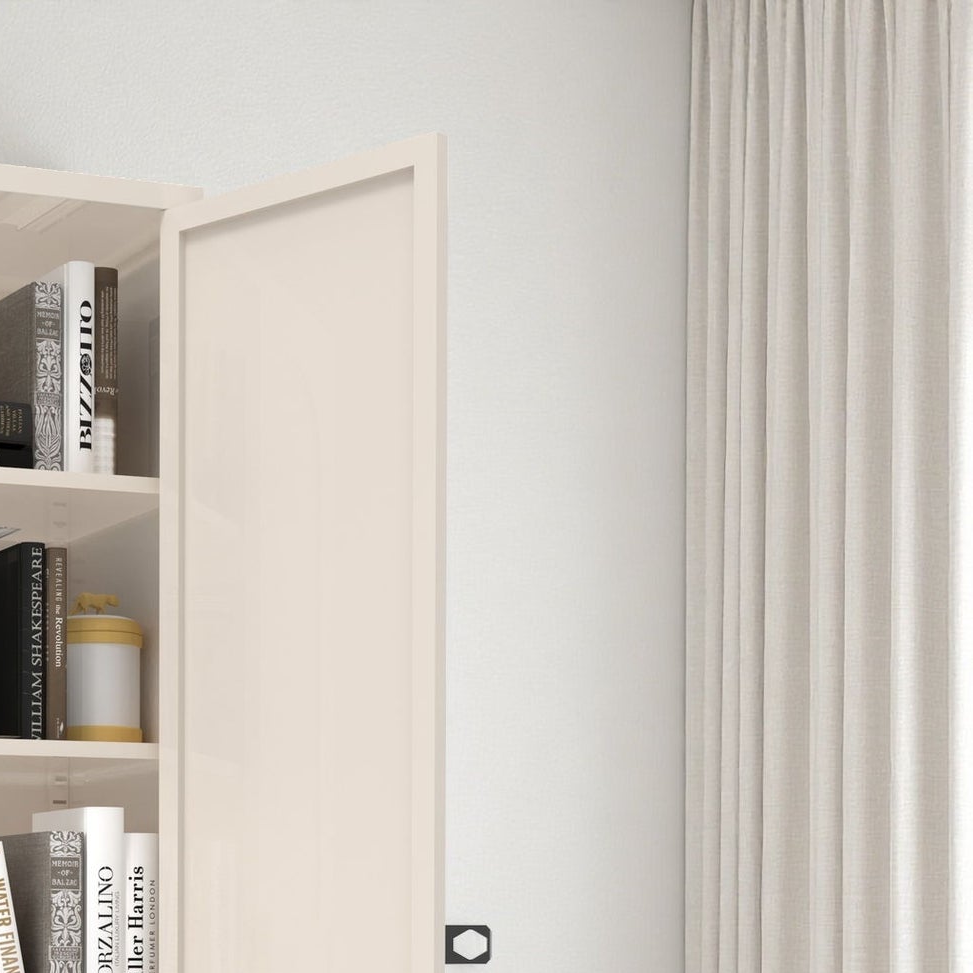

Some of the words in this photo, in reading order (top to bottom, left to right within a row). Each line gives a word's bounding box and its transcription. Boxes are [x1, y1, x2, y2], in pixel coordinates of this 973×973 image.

[31, 546, 43, 667] SHAKESPEARE
[55, 557, 63, 602] REVEALING
[55, 617, 64, 667] Revolution
[127, 866, 144, 930] Harris
